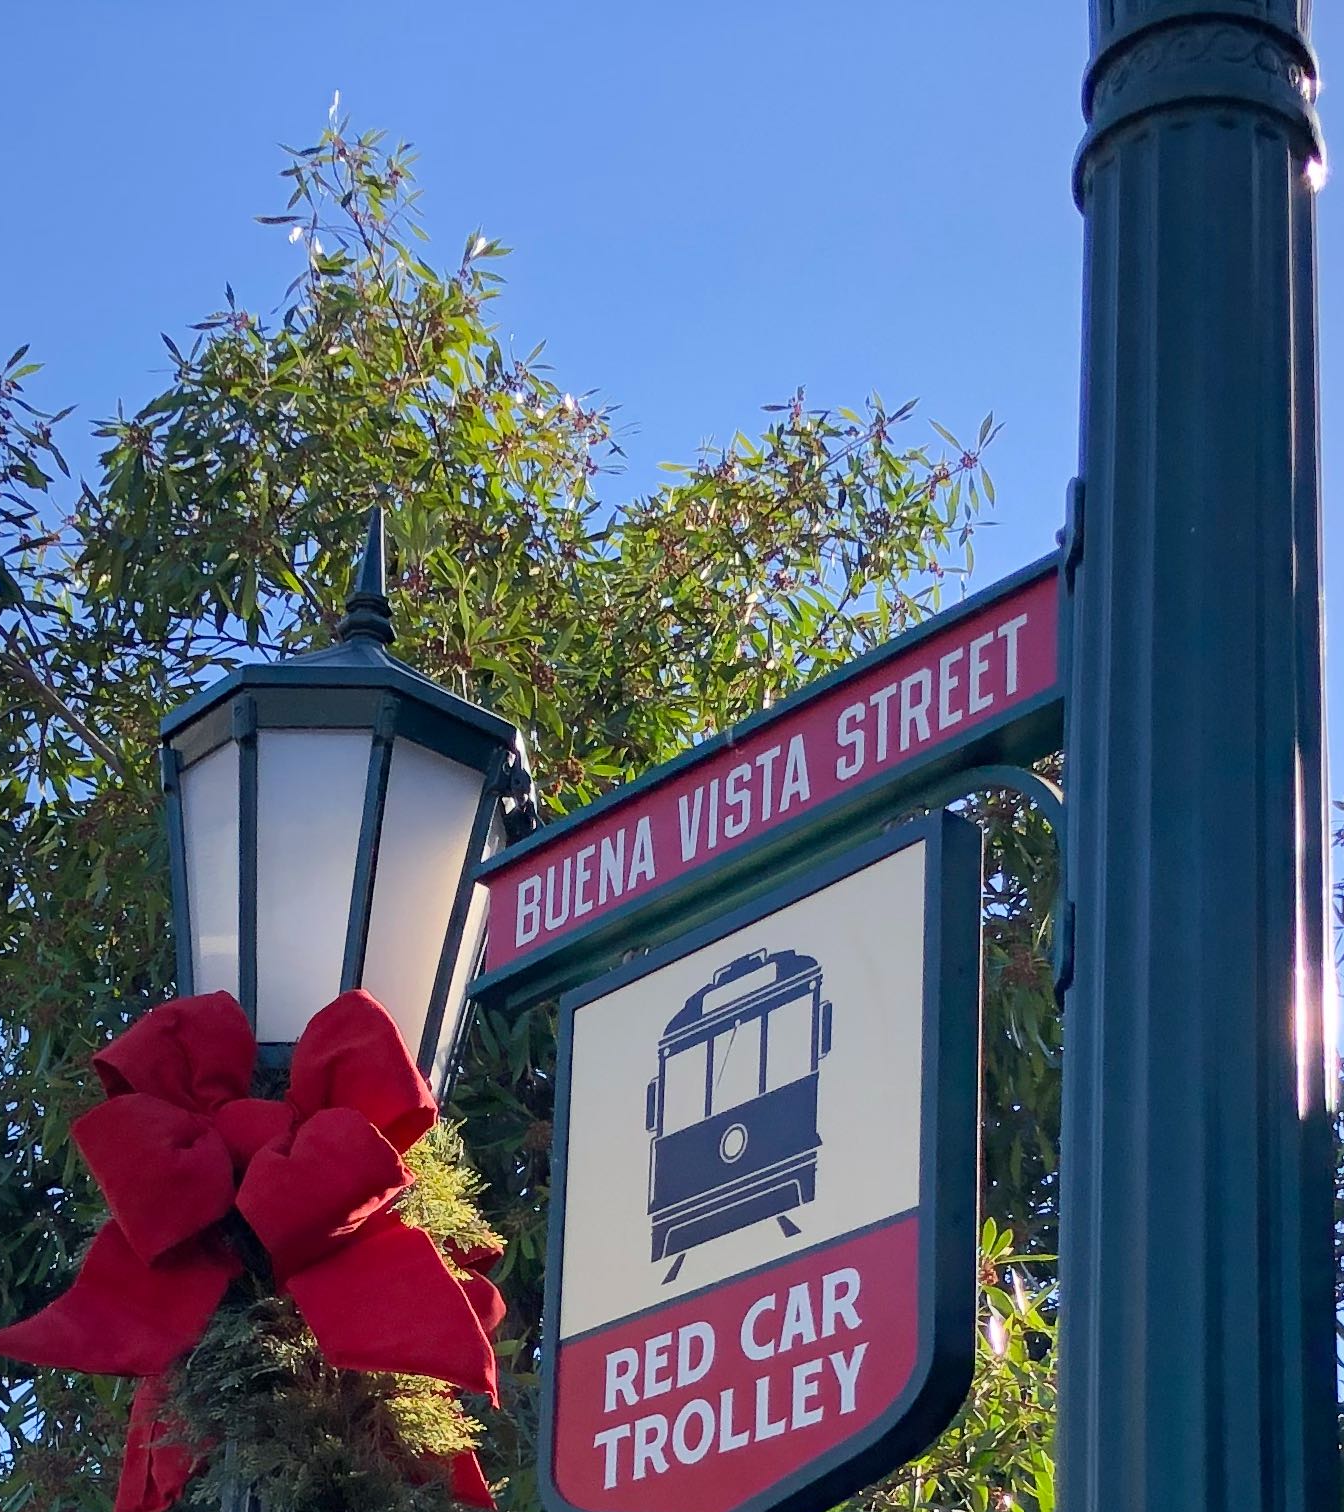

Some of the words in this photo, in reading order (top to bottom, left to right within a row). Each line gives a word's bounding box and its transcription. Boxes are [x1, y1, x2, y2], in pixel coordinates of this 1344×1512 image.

[515, 816, 655, 947] BUENA
[678, 734, 810, 862] VISTA
[836, 614, 1028, 780] STREET
[604, 1321, 716, 1413] RED
[740, 1267, 863, 1361] CAR
[593, 1342, 869, 1491] TROLLEY
